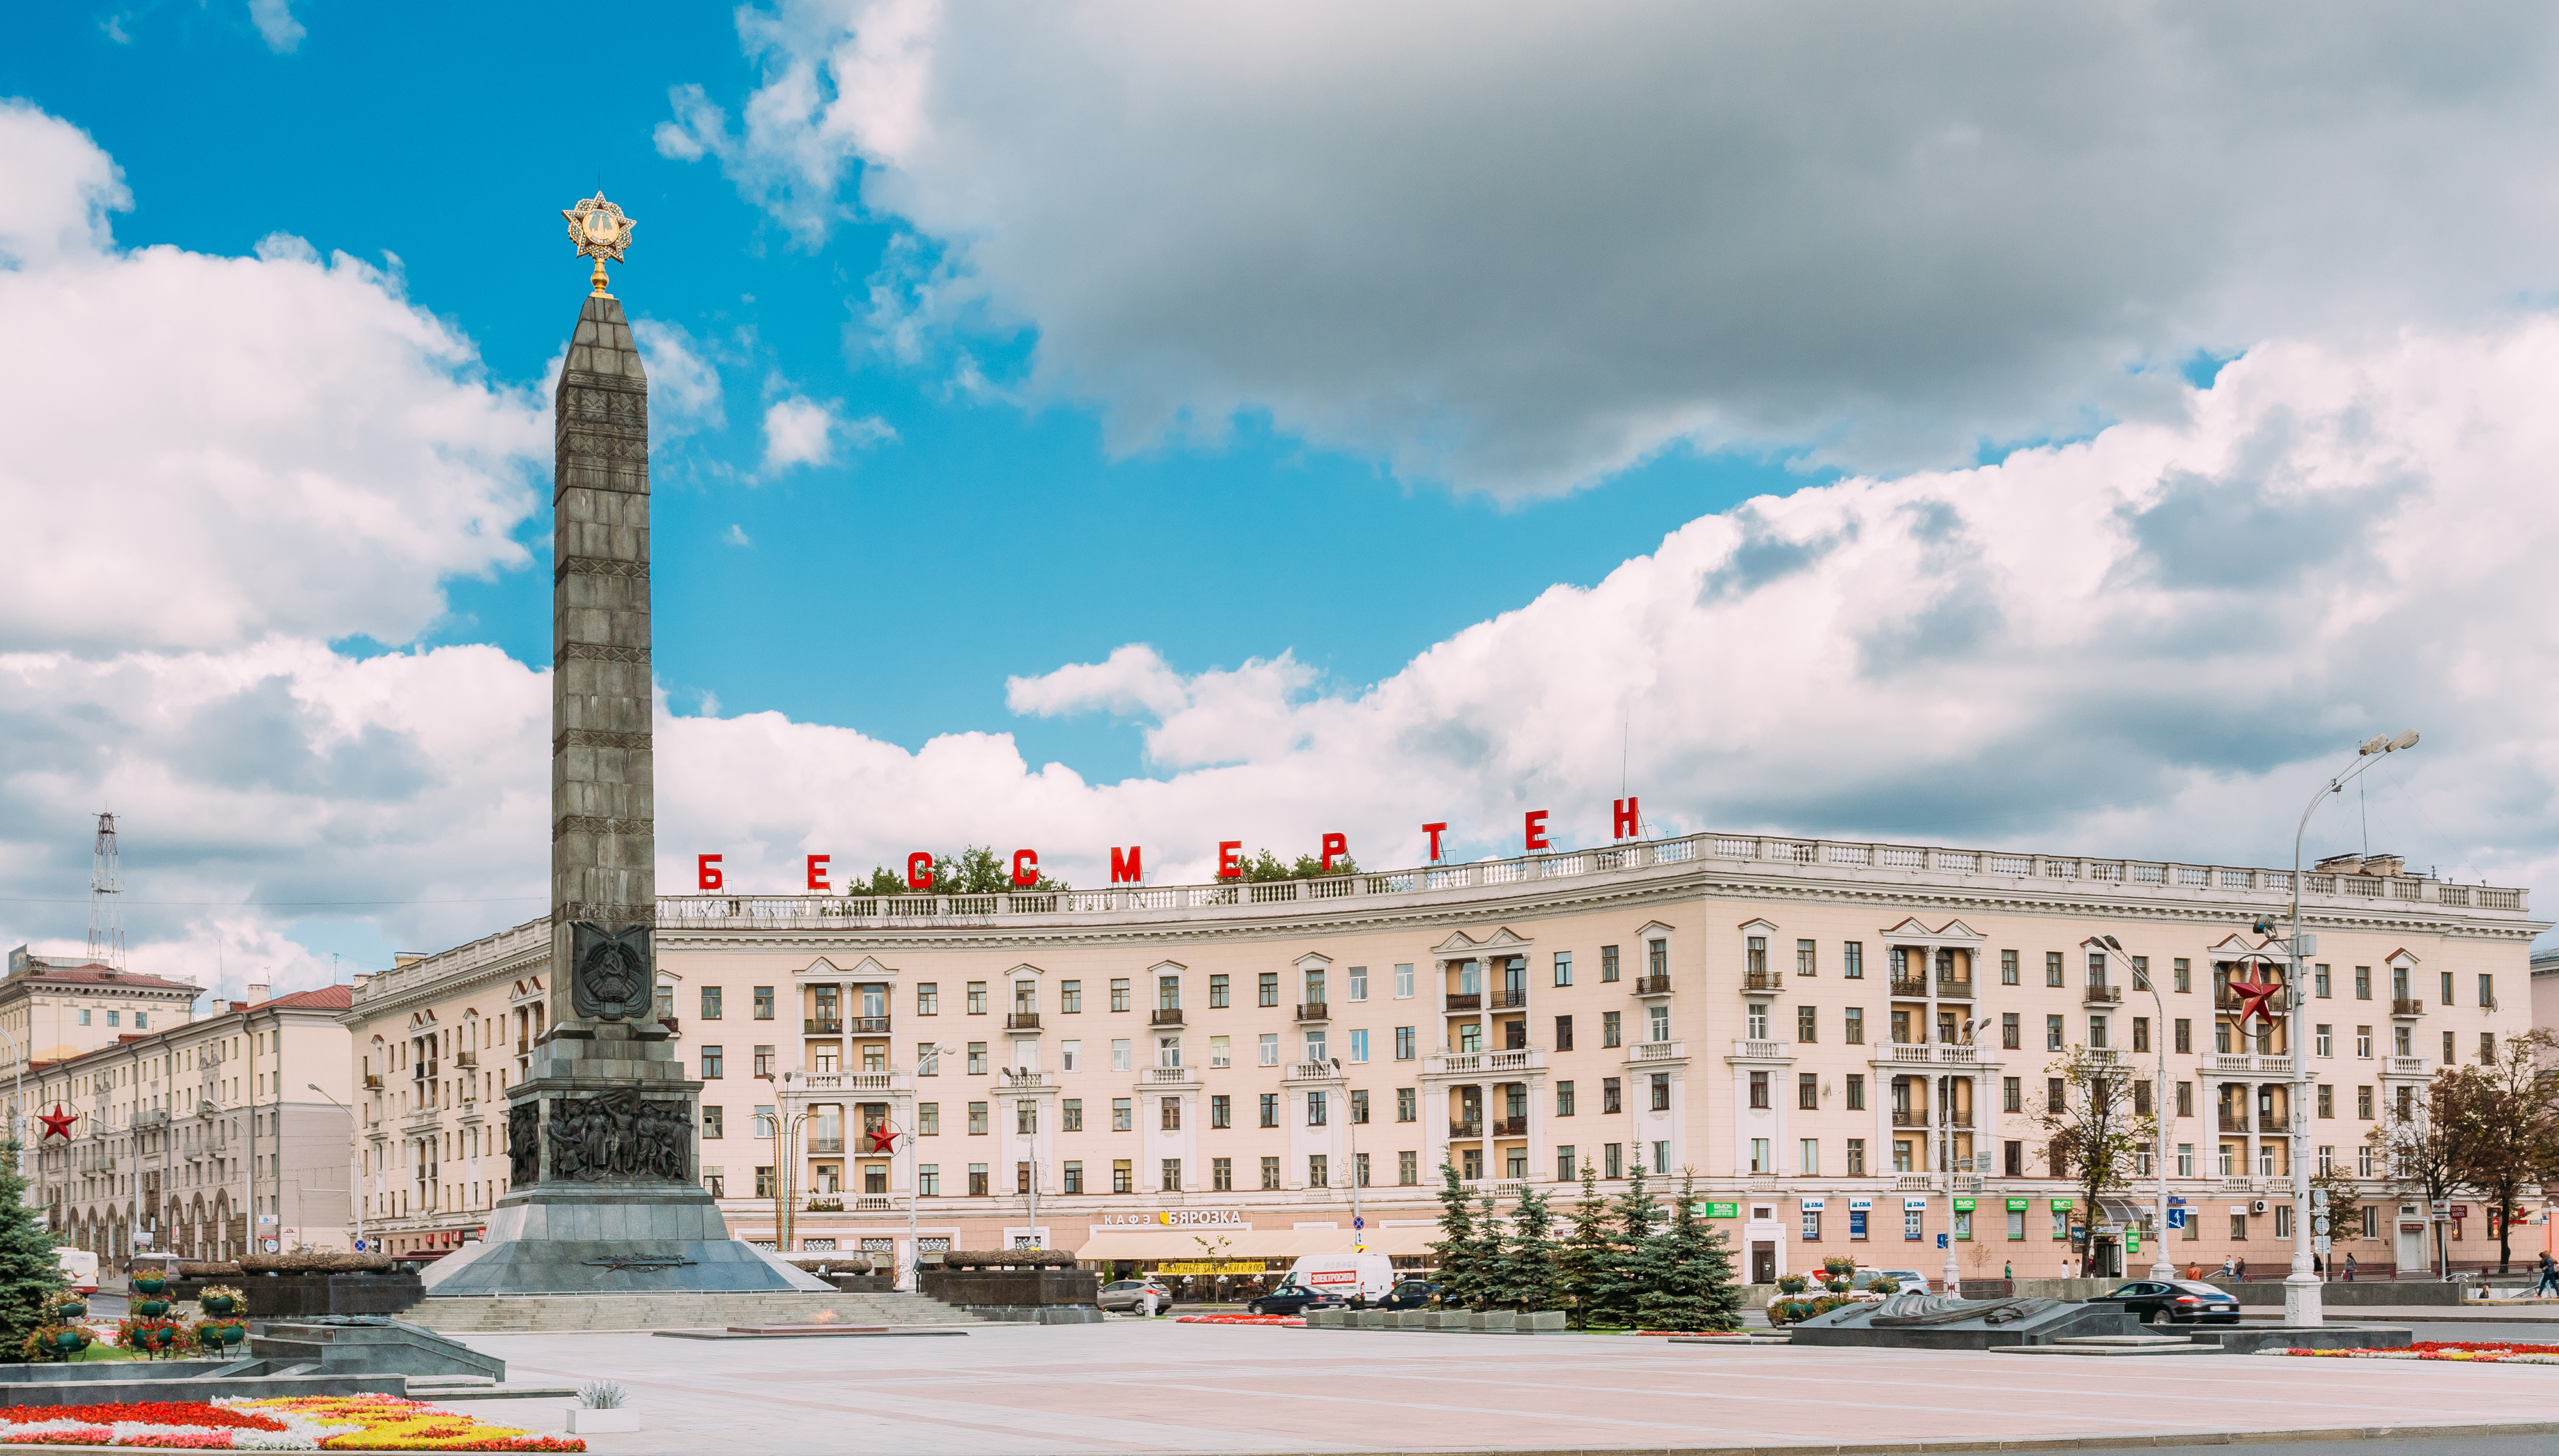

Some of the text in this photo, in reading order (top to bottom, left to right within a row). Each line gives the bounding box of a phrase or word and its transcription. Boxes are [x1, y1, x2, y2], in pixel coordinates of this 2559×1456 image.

[1105, 1211, 1241, 1225] КАФЭ БЯРОЗКА
[1312, 1273, 1355, 1283] ЭЛЕКТРОСИЛА
